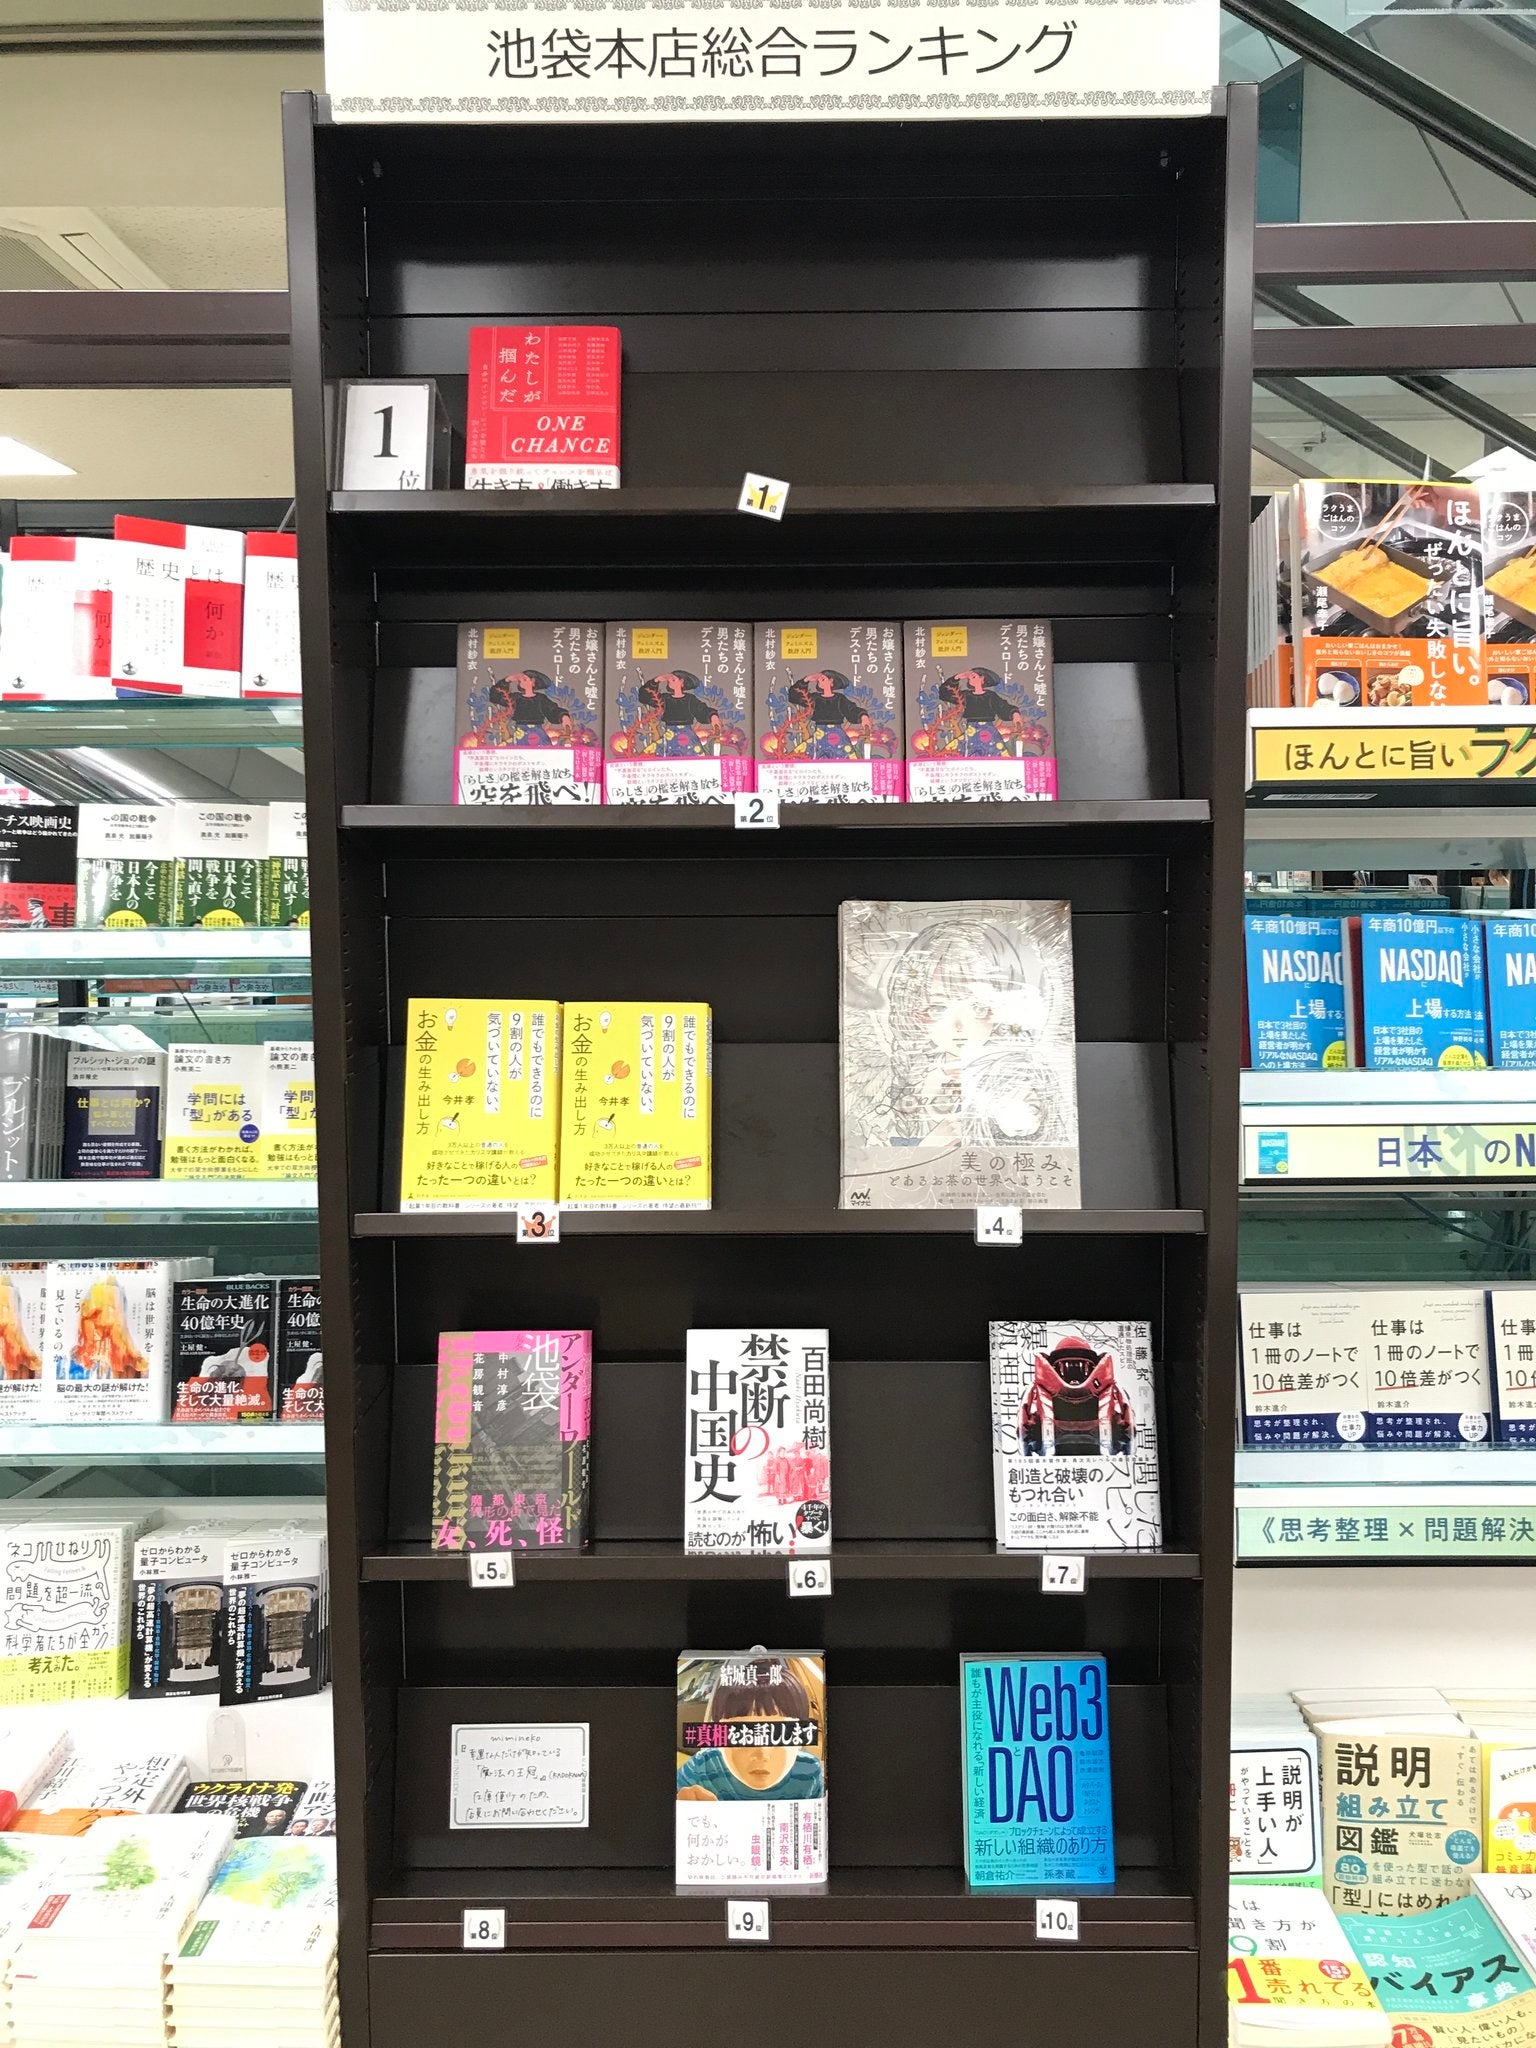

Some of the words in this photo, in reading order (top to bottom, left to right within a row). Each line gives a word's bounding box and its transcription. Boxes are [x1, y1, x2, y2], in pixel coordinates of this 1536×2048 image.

[487, 25, 1078, 80] 池袋本店総合ランキング
[498, 348, 518, 403] 掴んだ
[523, 332, 542, 404] わたしが
[373, 405, 399, 458] 1
[537, 415, 586, 432] ONE
[511, 437, 611, 454] CHANCE
[1321, 504, 1354, 513] ラクうま
[1321, 514, 1354, 523] ごはんの
[1330, 524, 1347, 533] コツ
[136, 557, 225, 584] 歴史とは
[1447, 499, 1481, 687] ほんとに旨い。
[1315, 586, 1330, 632] 瀬尾幸子
[205, 600, 225, 641] 何か
[1424, 541, 1447, 707] ぜったい失敗しな
[552, 627, 565, 688] デス・ロード
[568, 628, 582, 674] 男たちの
[716, 628, 730, 674] 男たちの
[865, 627, 878, 674] 男たちの
[585, 628, 599, 710] お嬢さんと嘘と
[1285, 740, 1455, 771] ほんとに旨い
[198, 812, 252, 822] この国の戦争
[126, 861, 141, 910] 日本人の
[144, 861, 159, 901] 今こそ
[205, 859, 220, 900] 戦争を
[222, 860, 237, 909] 日本人の
[240, 860, 254, 899] 今こそ
[1380, 947, 1464, 988] NASDAQ
[1405, 998, 1472, 1020] 上場する方法
[1257, 1020, 1308, 1030] 日本で3社目の
[1257, 1030, 1309, 1041] 上場を果たした
[509, 1013, 523, 1080] 9割の人が
[661, 1014, 676, 1081] 9割の人が
[1258, 1041, 1313, 1051] 経営者が明かす
[1373, 1036, 1424, 1046] 上場を果たした
[174, 1054, 232, 1065] 論文の書き方
[530, 1013, 545, 1118] 誰でもできるのに
[683, 1015, 697, 1119] 誰でもできるのに
[1259, 1051, 1318, 1061] リアルなNASDAQ
[415, 1009, 439, 1136] お金の生み出し方
[571, 1013, 594, 1136] お金の生み出し方
[77, 1097, 151, 1109] 仕事とは何か?
[187, 1092, 247, 1107] 学問には
[442, 1095, 476, 1107] 今井孝
[599, 1096, 630, 1107] 今井孝
[182, 1108, 253, 1123] 「型」がある
[2, 1075, 30, 1180] ブルシット・
[170, 1155, 260, 1164] 勉強はもっと面白くなる。
[177, 1145, 254, 1153] 書く方法がわかれば、
[1378, 1134, 1443, 1168] 日本
[427, 1161, 518, 1171] 好きなことで稼げる人の
[960, 1151, 1074, 1173] 美の極み、
[889, 1174, 1074, 1187] とあるお茶の世界へようこそ
[74, 1289, 84, 1313] どう
[181, 1294, 270, 1311] 生命の大進化
[145, 1287, 156, 1353] 脳は世界を
[180, 1314, 246, 1331] 40億年史
[1249, 1321, 1302, 1340] 仕事は
[1371, 1319, 1424, 1337] 仕事は
[1501, 1319, 1536, 1336] 仕事
[1134, 1325, 1150, 1381] 佐藤究
[1252, 1346, 1359, 1365] 1冊のノートで
[1374, 1343, 1480, 1362] 1冊のノートで
[1504, 1344, 1534, 1361] 1冊
[472, 1352, 485, 1413] 花房観音
[495, 1352, 510, 1413] 中村淳彦
[521, 1333, 560, 1412] 池袋
[1253, 1371, 1360, 1391] 10倍差がつく
[1375, 1368, 1481, 1387] 10倍差がつく
[56, 1383, 149, 1393] 脳の最大の謎が解けた!
[176, 1381, 245, 1394] 生命の進化、
[730, 1333, 792, 1460] 禁断の
[802, 1346, 827, 1450] 百田尚樹
[176, 1394, 266, 1407] そして大量絶滅。
[560, 1332, 583, 1531] アンダーワールド
[689, 1359, 742, 1504] 中国史
[1253, 1418, 1325, 1428] 思考が整理され、
[1341, 1424, 1362, 1432] 仕事力
[1254, 1430, 1335, 1441] 悩みや問題が解決。
[1008, 1467, 1104, 1485] 創造と破壊の
[1008, 1486, 1084, 1503] もつれ合い
[1009, 1511, 1100, 1522] この面白さ、解除不能
[140, 1544, 201, 1556] ゼロからわかる
[140, 1555, 208, 1567] 量子コンピュータ
[230, 1547, 291, 1561] ゼロからわかる
[230, 1557, 299, 1572] 量子コンピュータ
[136, 1584, 146, 1640] 世界のこれから
[6, 1623, 108, 1651] 科学者たちが全力で
[28, 1654, 80, 1675] 考えてみた。
[720, 1664, 782, 1687] 結城真一郎
[984, 1665, 1103, 1742] Web3
[685, 1722, 818, 1747] #真相をお話しします
[970, 1668, 986, 1826] 誰もが主役になれる「新しい経済」
[1014, 1747, 1022, 1757] と
[1335, 1743, 1431, 1788] 説明
[989, 1745, 1074, 1823] DAO
[1282, 1757, 1305, 1832] 「説明が
[1468, 1745, 1477, 1825] あてはめるだけで
[185, 1794, 294, 1808] 世界核戦争
[1336, 1792, 1448, 1819] 組み立て
[687, 1815, 718, 1829] でも、
[1240, 1767, 1252, 1858] がやっていることを
[1256, 1765, 1278, 1865] 上手い人」
[687, 1833, 729, 1848] 何かが
[802, 1811, 813, 1866] 有栖川有栖
[1009, 1826, 1108, 1837] ブロックチェーンによって成立する
[1336, 1826, 1399, 1856] 図鑑
[779, 1822, 789, 1867] 南沢奈央
[974, 1838, 1108, 1856] 新しい組織のあり方
[687, 1853, 746, 1867] おかしい。
[1372, 1861, 1463, 1875] を使った型で話の
[975, 1870, 1015, 1880] 朝倉祐介
[1044, 1870, 1076, 1880] 孫泰蔵
[1362, 1952, 1417, 1969] 認知
[1370, 1954, 1520, 1996] バイアス
[1265, 1978, 1372, 1998] 売れてる
